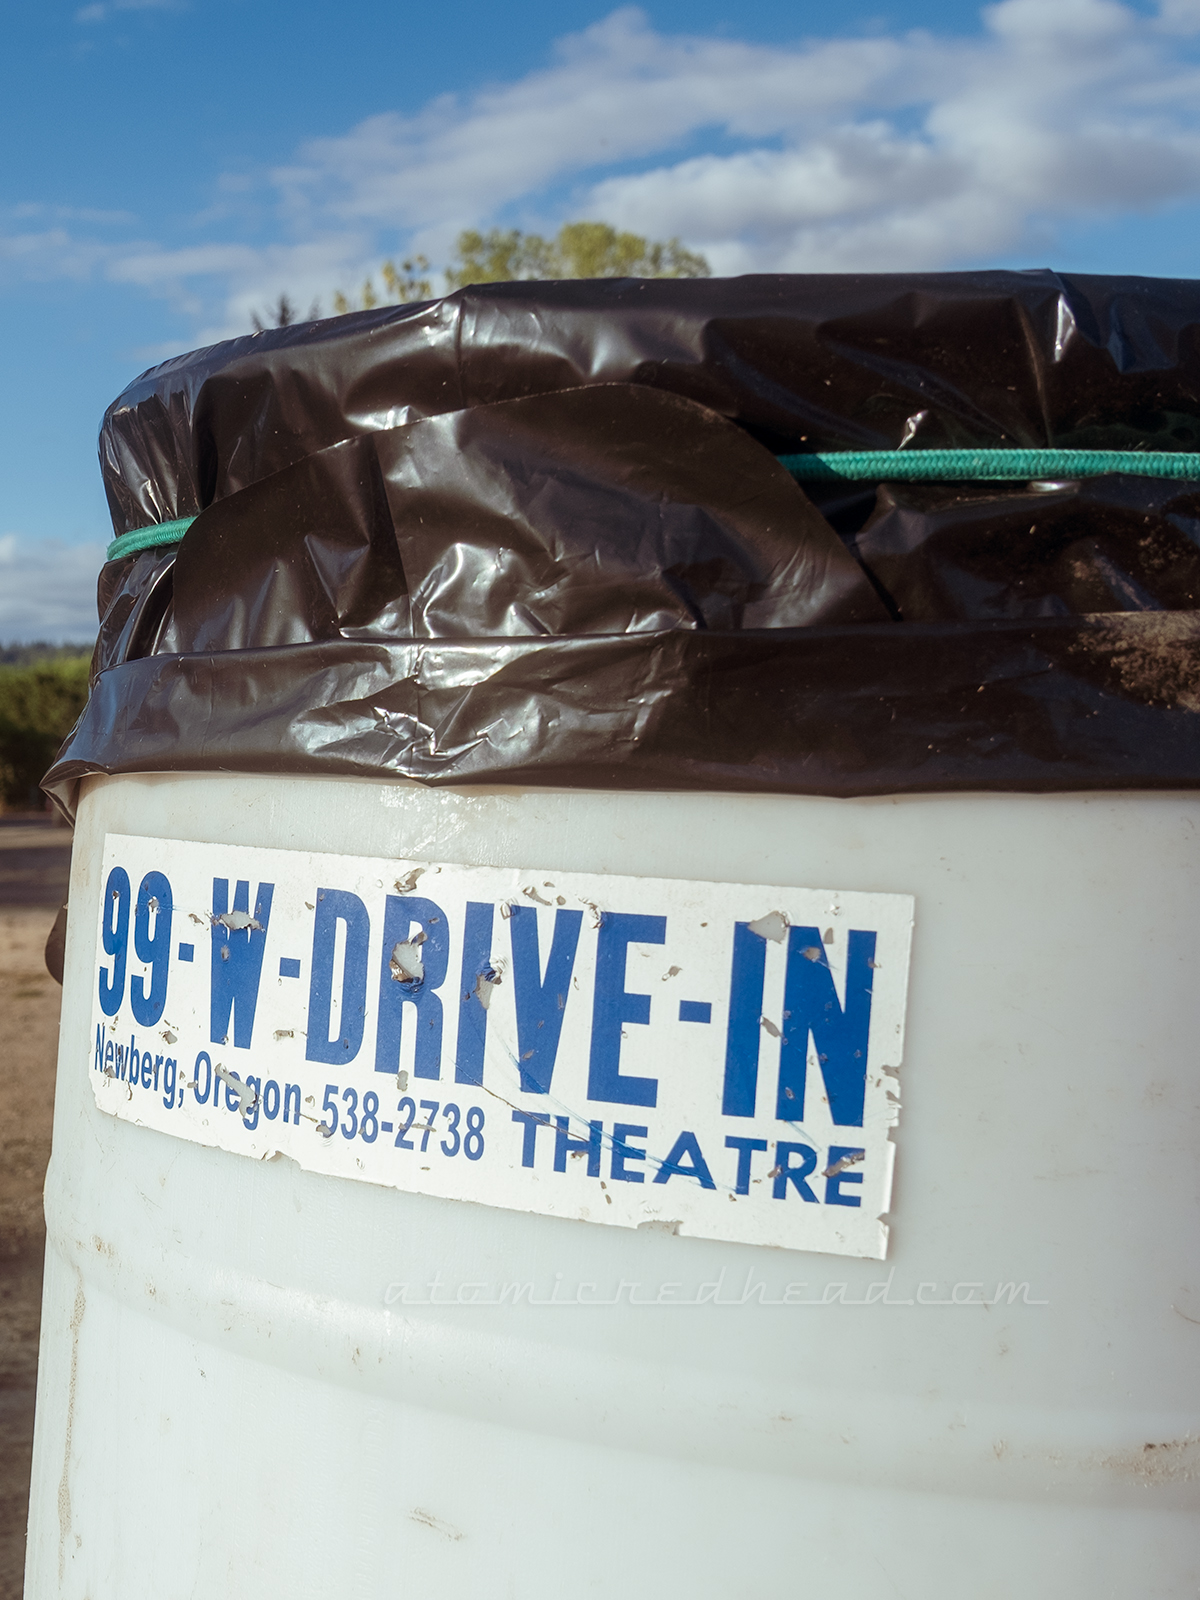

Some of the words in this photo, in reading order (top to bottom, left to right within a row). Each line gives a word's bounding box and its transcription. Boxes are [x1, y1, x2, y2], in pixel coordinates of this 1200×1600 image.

[94, 1023, 185, 1110] Newberg,
[193, 1050, 301, 1131] Oregon
[320, 1084, 485, 1161] 538-2738
[511, 1110, 865, 1207] THEATRE
